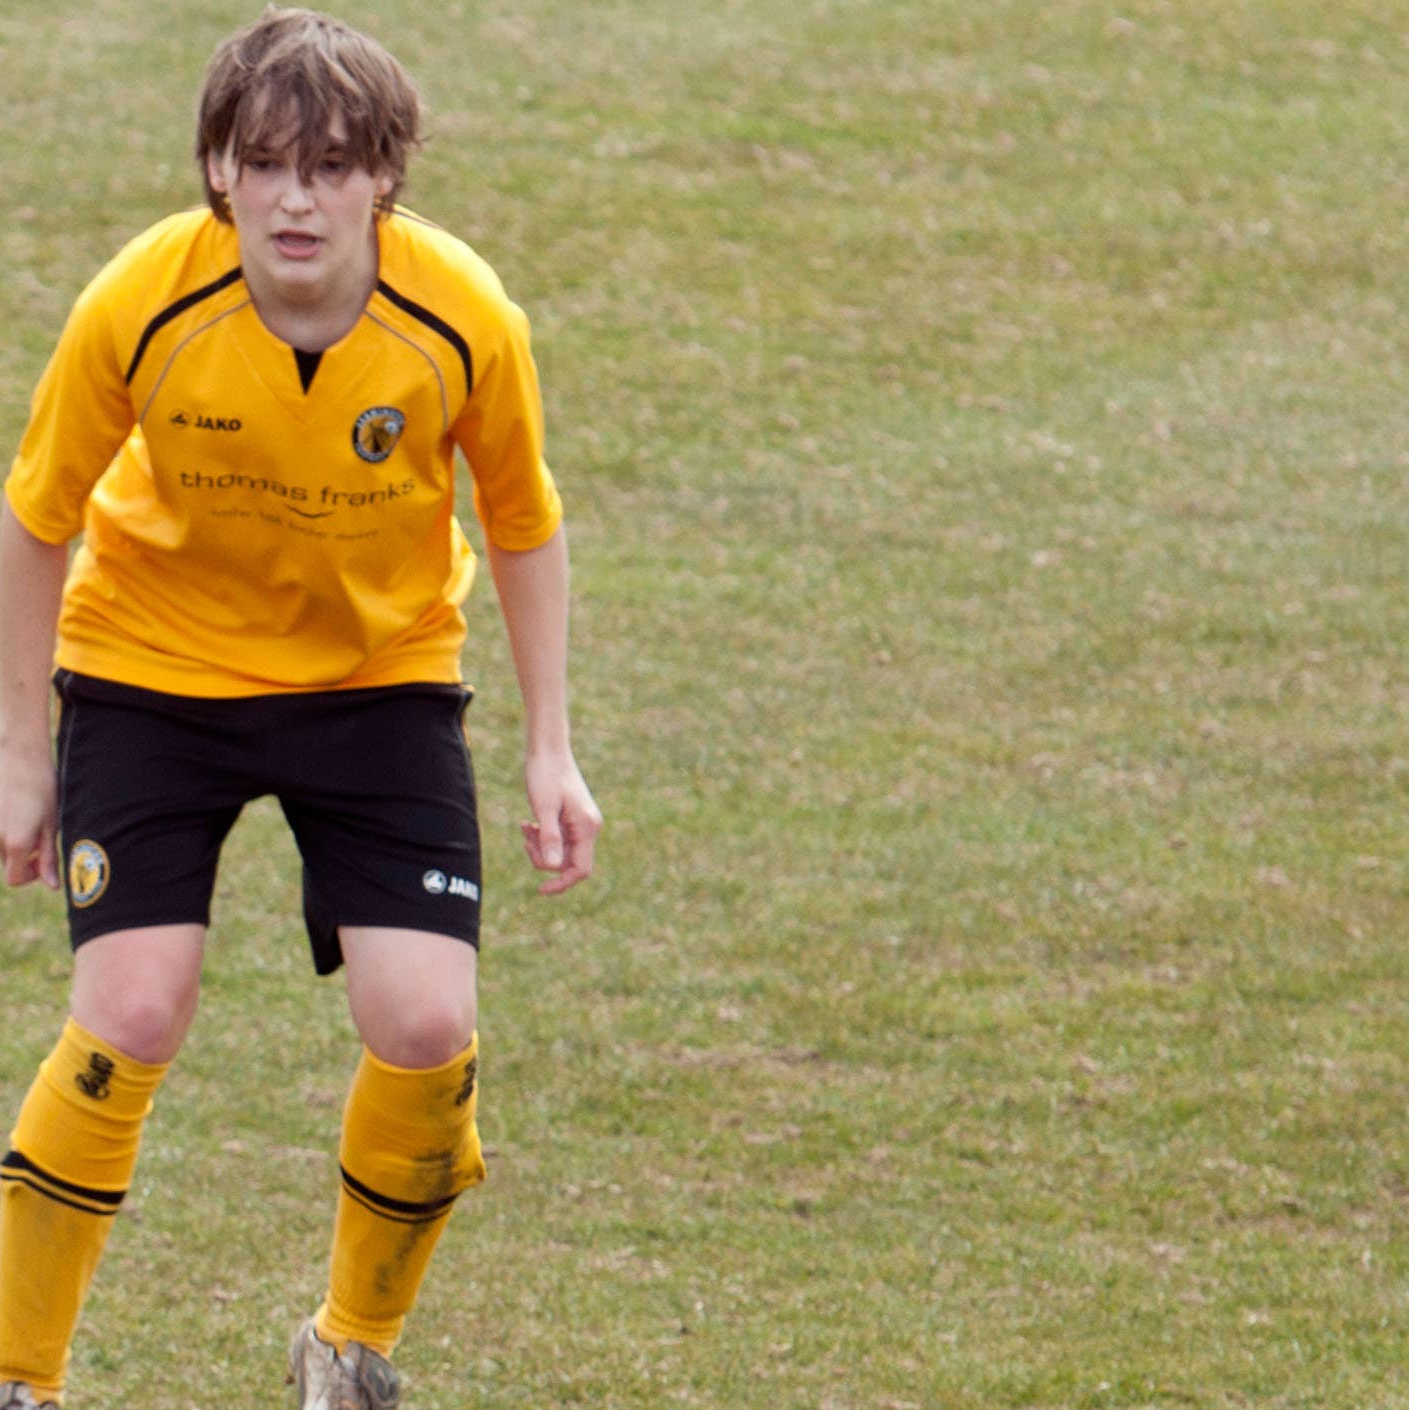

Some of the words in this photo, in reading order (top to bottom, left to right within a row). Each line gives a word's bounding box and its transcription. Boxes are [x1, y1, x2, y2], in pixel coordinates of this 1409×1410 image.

[194, 415, 242, 433] JAKO
[180, 471, 307, 501] thomas
[320, 478, 415, 507] franks
